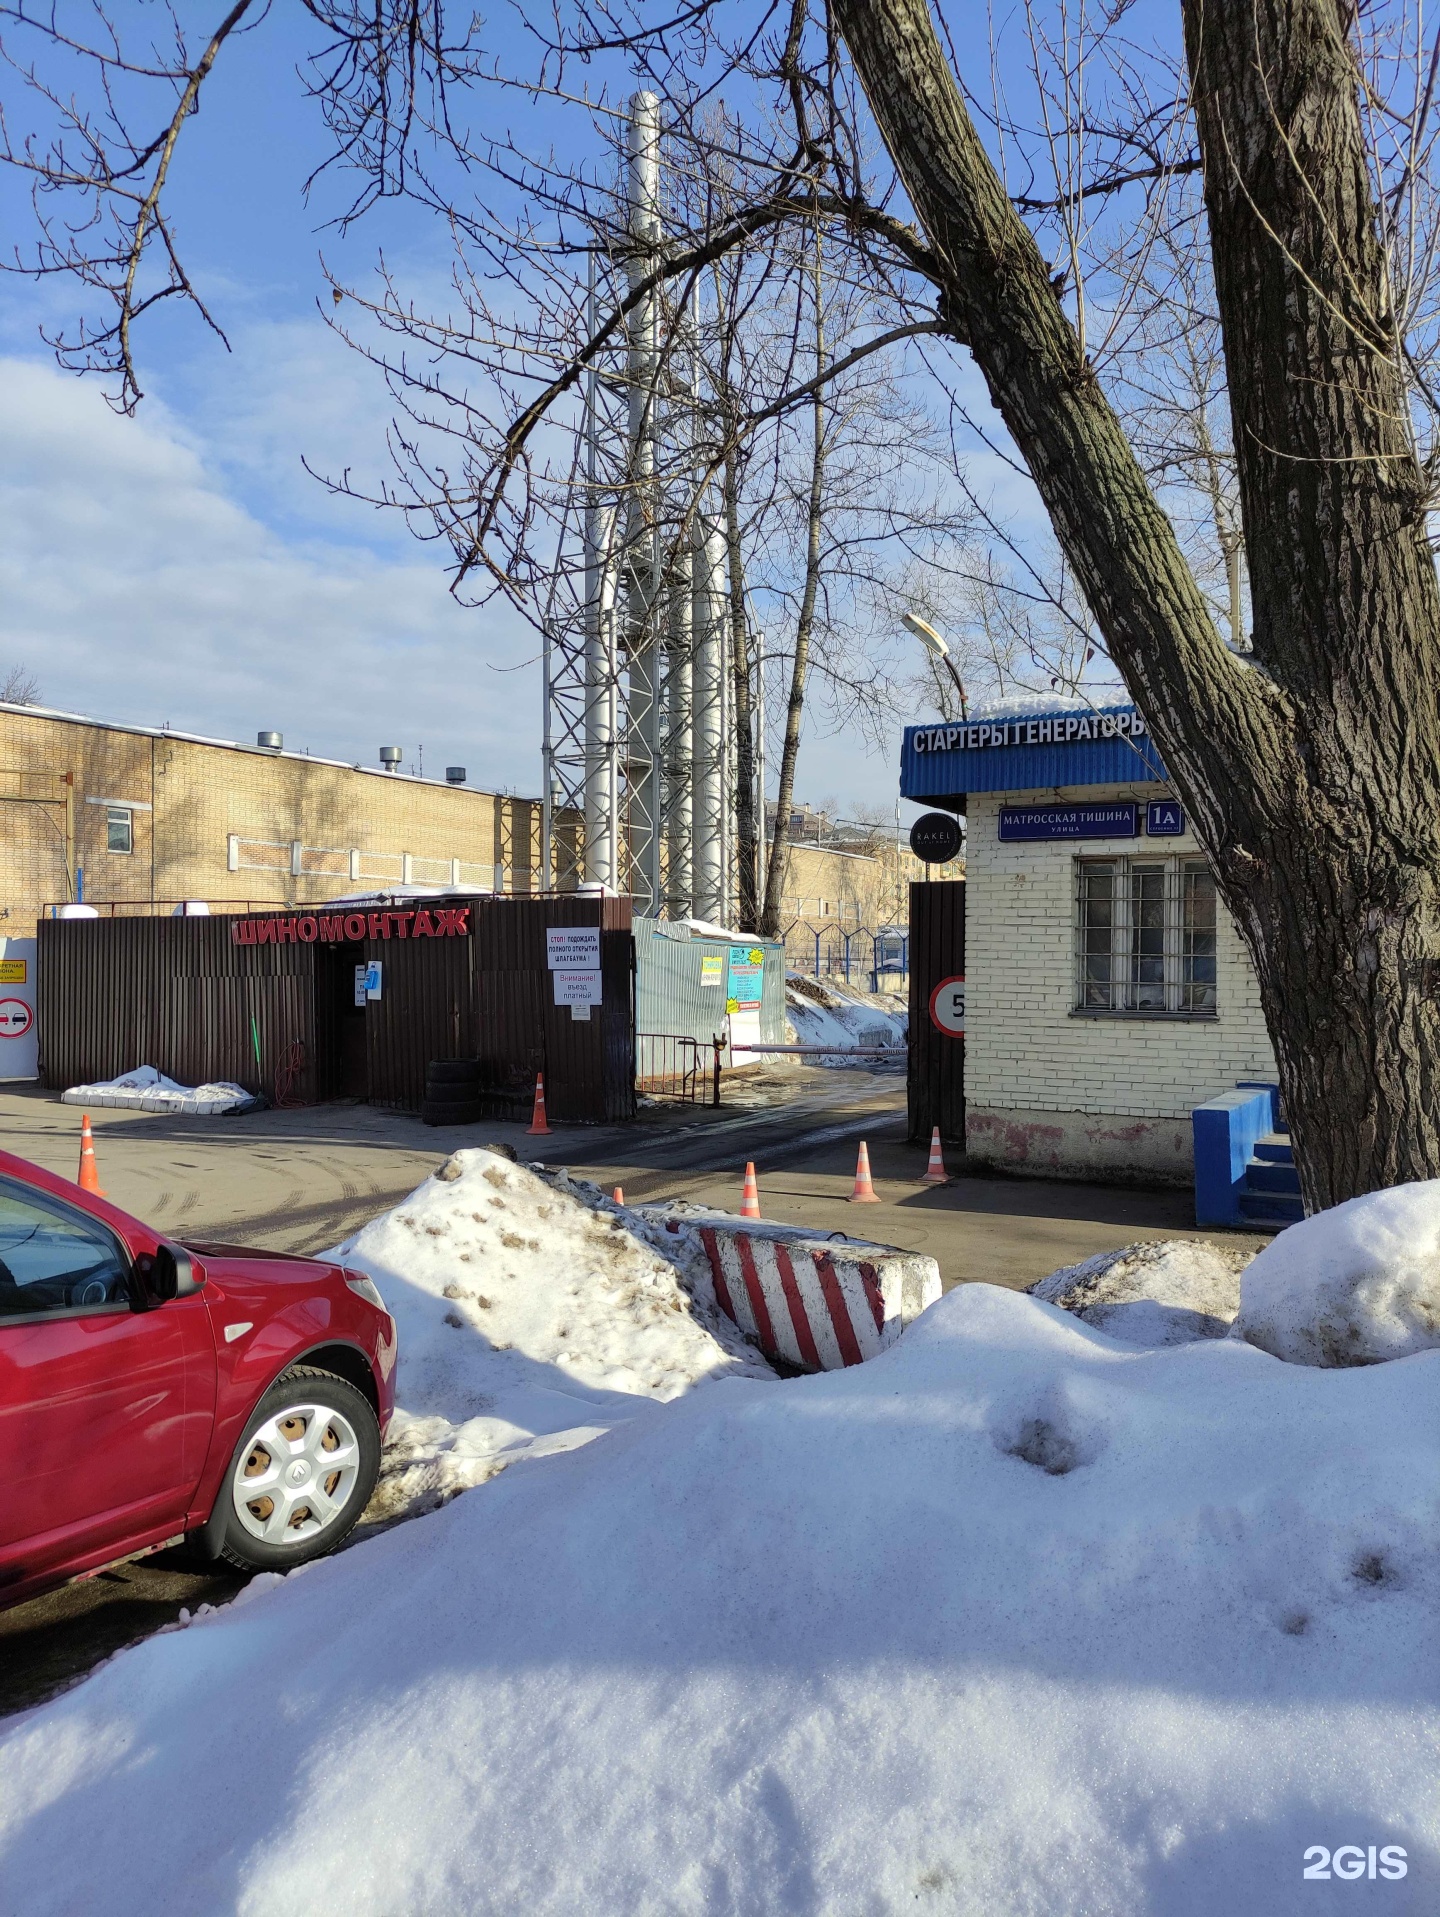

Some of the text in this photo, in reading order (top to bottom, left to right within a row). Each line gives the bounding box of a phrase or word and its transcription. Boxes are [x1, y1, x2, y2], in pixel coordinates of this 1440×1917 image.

[913, 722, 1009, 753] СТАРТЕРЫ
[1003, 811, 1131, 825] МАТРОССКАЯ ТИШИНА
[1153, 806, 1176, 824] 1А
[917, 831, 950, 840] RAKEL
[231, 908, 469, 945] ШИНОМОНТАЖ
[567, 935, 597, 943] ПОДОЖДАТЬ
[560, 974, 596, 982] Внимание!
[563, 991, 592, 999] платный
[952, 994, 965, 1017] 5
